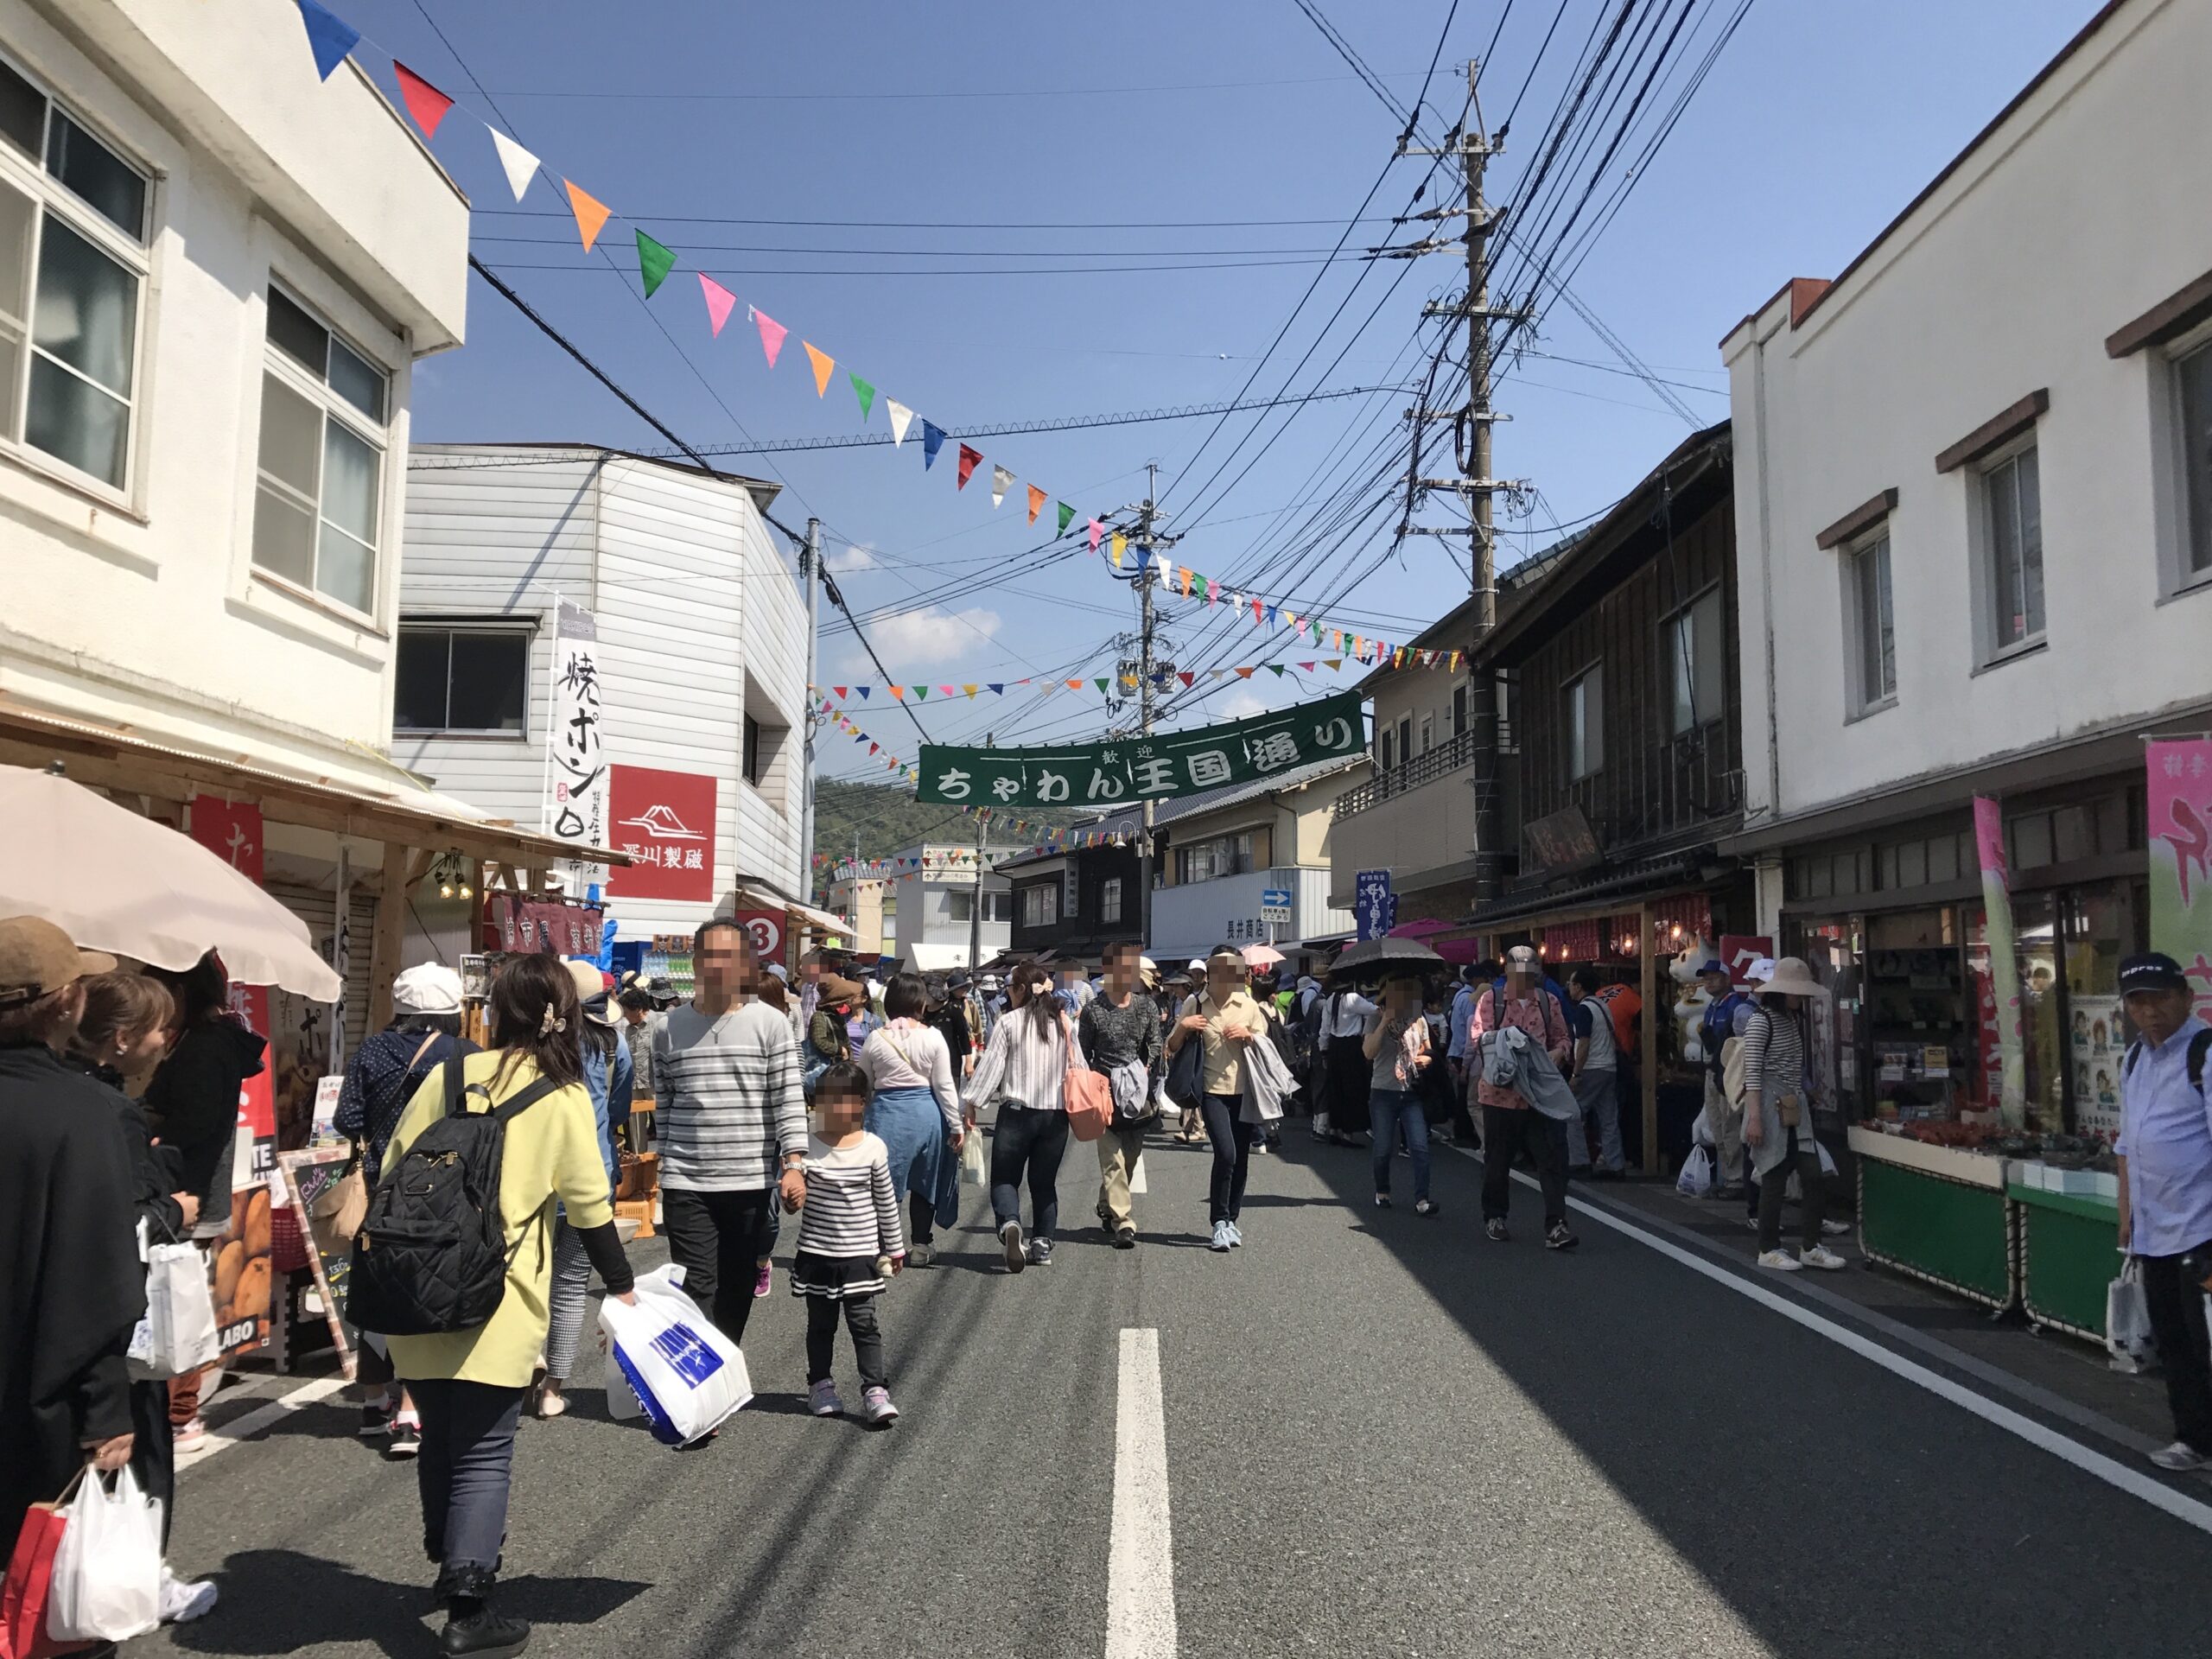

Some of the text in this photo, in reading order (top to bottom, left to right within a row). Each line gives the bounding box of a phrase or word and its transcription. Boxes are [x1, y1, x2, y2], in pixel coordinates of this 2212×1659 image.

[938, 716, 1352, 803] ちゃわん王国通り
[1102, 746, 1155, 766] 歓迎
[622, 842, 703, 870] 深川製磁
[1227, 918, 1263, 939] 長井商店
[300, 1167, 327, 1200] にんじん
